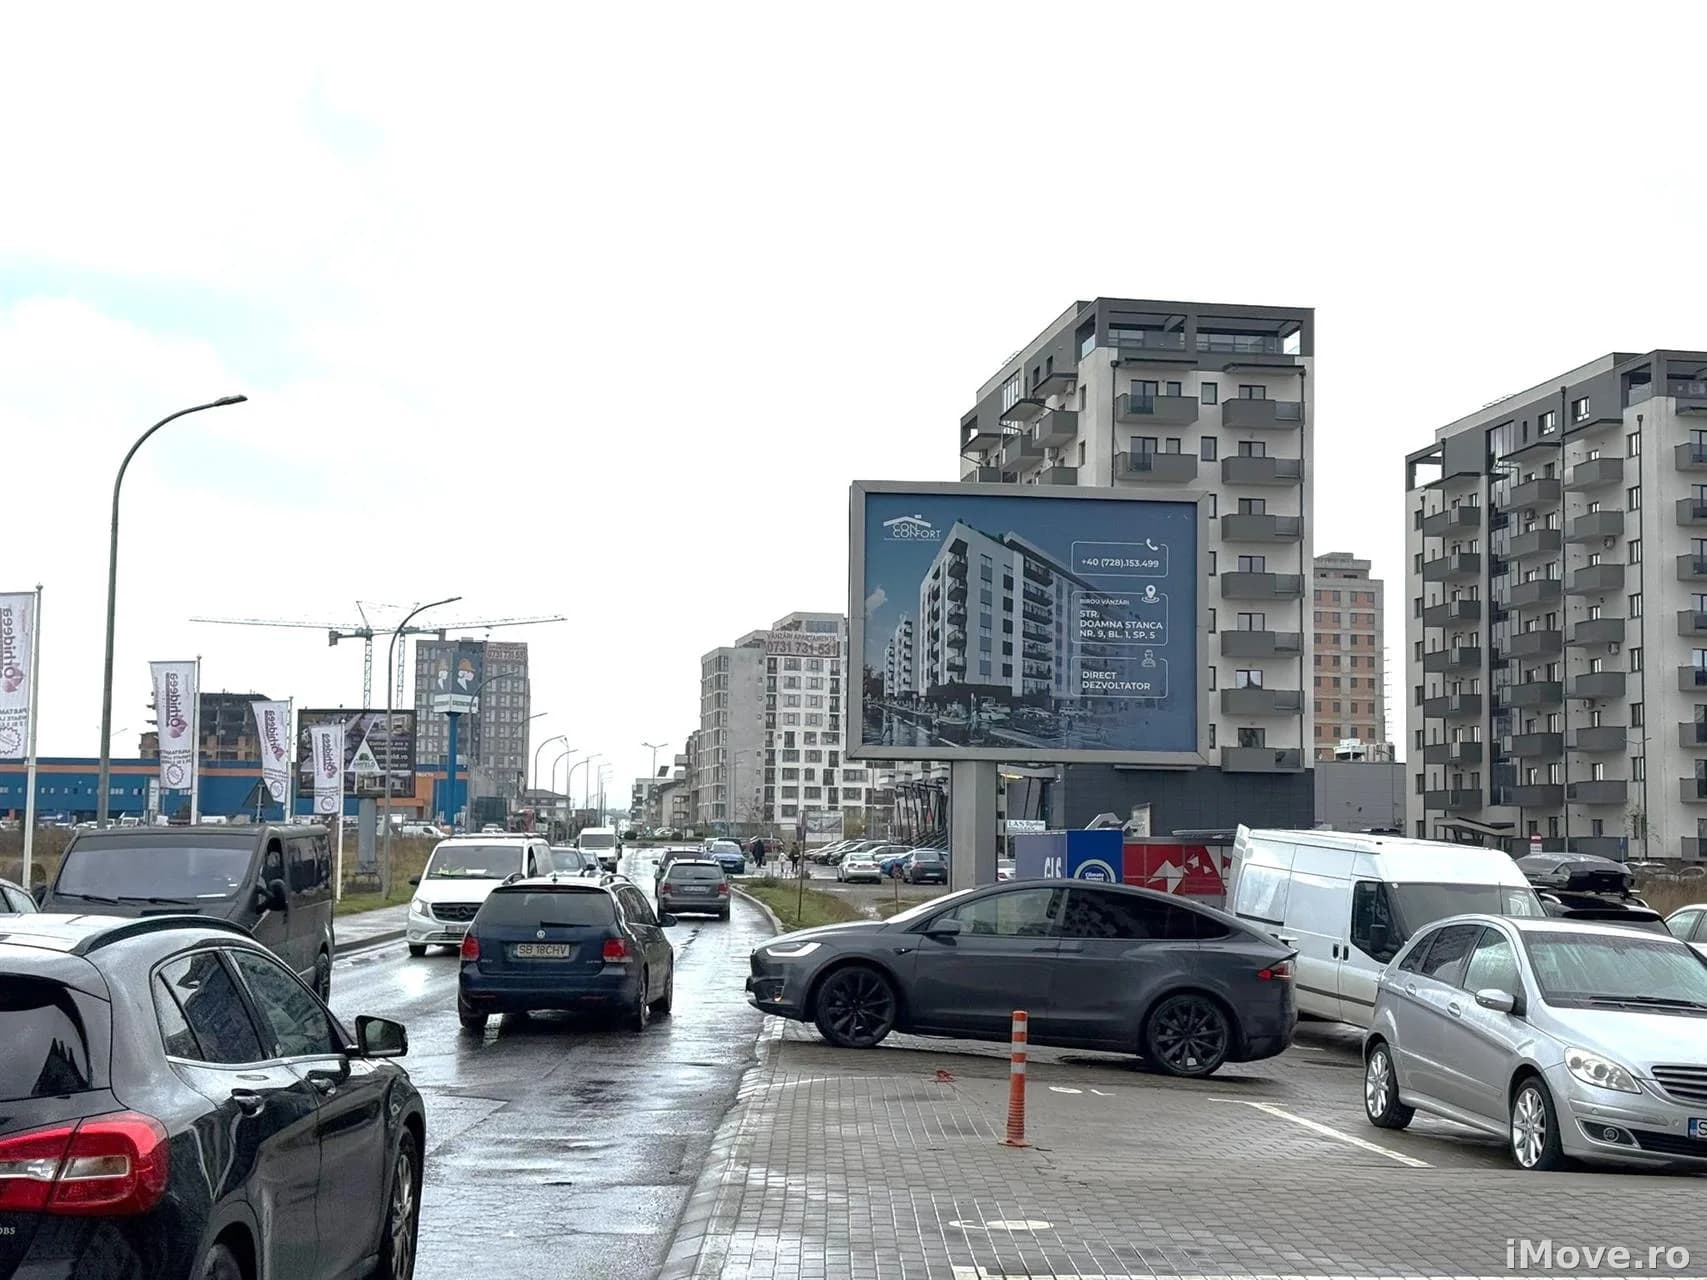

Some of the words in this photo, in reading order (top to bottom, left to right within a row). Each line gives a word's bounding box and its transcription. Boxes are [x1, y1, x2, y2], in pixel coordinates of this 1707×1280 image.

[892, 529, 942, 538] CONFORT
[1081, 558, 1099, 567] +40
[1101, 558, 1160, 569] (728).153.499
[1079, 610, 1100, 618] STR.
[1080, 619, 1123, 629] DOAMNA
[1125, 621, 1163, 630] STANCA
[1079, 629, 1096, 638] NR.
[1097, 630, 1106, 639] 9,
[1108, 630, 1123, 639] BL.
[1132, 631, 1148, 640] SP.
[1149, 631, 1156, 640] 5
[1082, 671, 1117, 680] DIRECT
[1082, 681, 1151, 690] DEZVOLTATOR
[518, 944, 533, 954] SB
